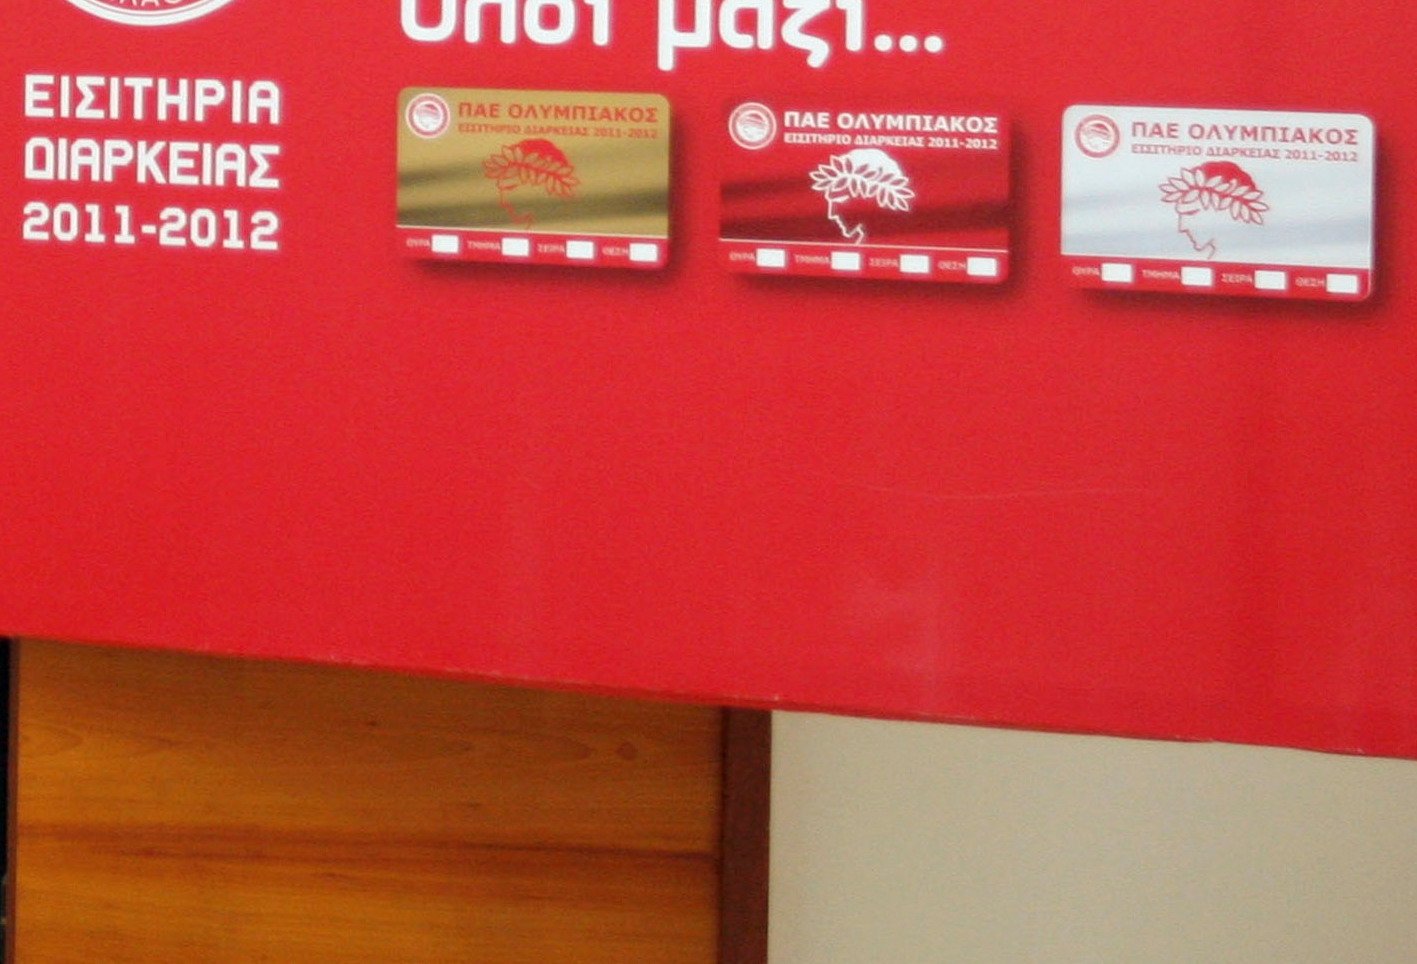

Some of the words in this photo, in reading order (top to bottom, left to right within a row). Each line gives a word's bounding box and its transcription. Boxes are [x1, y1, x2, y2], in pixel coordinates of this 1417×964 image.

[24, 74, 281, 125] ΕΙΣΙΤΗΡΙΑ
[458, 102, 501, 118] ΠΑΕ
[508, 103, 659, 124] ΟΛΥΜΠΙΑΚΟΣ
[783, 111, 830, 129] ΠΑΕ
[837, 112, 998, 134] ΟΛΥΜΠΙΑΚΟΣ
[524, 125, 589, 137] ΔΙΑΡΚΕΙΑΣ
[783, 133, 852, 145] ΕΙΣΙΤΗΡΙΟ
[854, 135, 925, 148] ΔΙΑΡΚΕΙΑΣ
[928, 137, 998, 150] 2011-2012
[1131, 121, 1179, 139] ΠΑΕ
[1188, 123, 1359, 146] ΟΛΥΜΠΙΑΚΟΣ
[24, 136, 281, 189] ΔΙΑΡΚΕΙΑΣ
[1131, 144, 1202, 156] ΕΙΣΙΤΗΡΙΟ
[1205, 146, 1280, 160] ΔΙΑΡΚΕΙΑΣ
[1285, 149, 1359, 162] 2011-2012
[22, 201, 279, 251] 2011-2012
